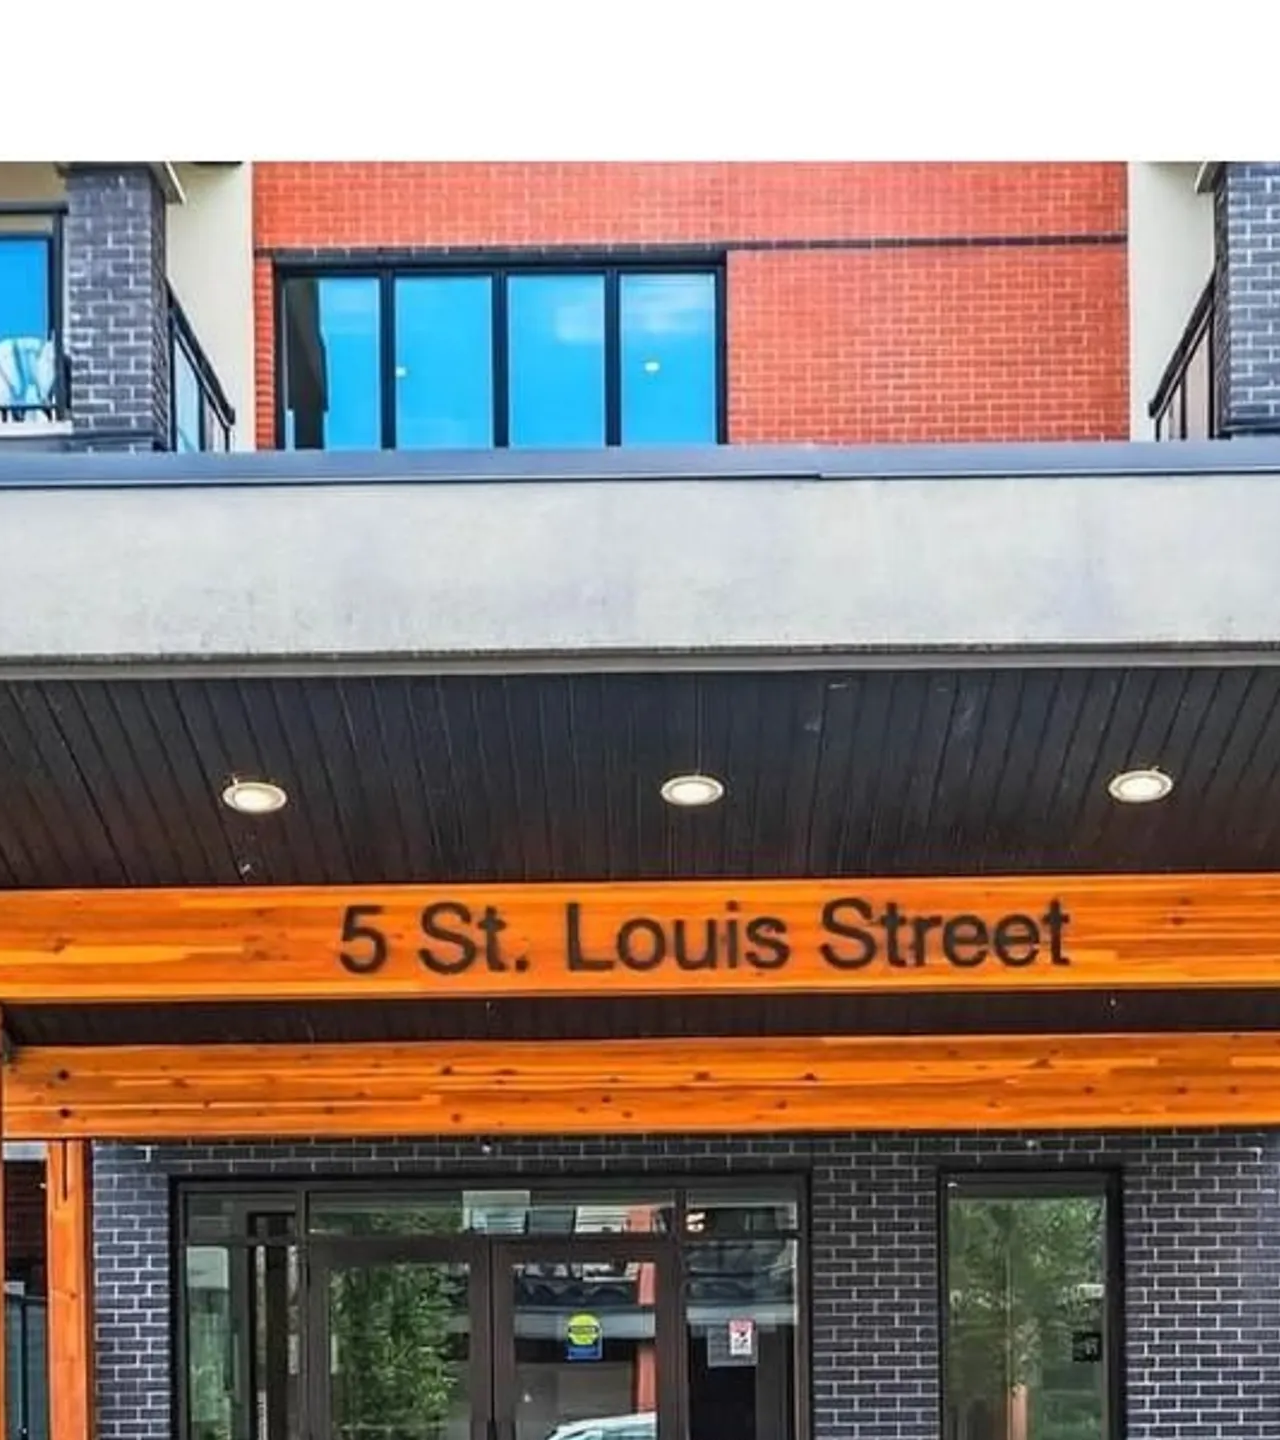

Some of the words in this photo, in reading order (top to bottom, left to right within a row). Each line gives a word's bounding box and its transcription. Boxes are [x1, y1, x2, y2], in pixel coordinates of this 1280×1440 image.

[339, 904, 389, 975] 5
[418, 902, 529, 975] St.
[566, 901, 791, 972] Louis
[820, 897, 1070, 970] Street
